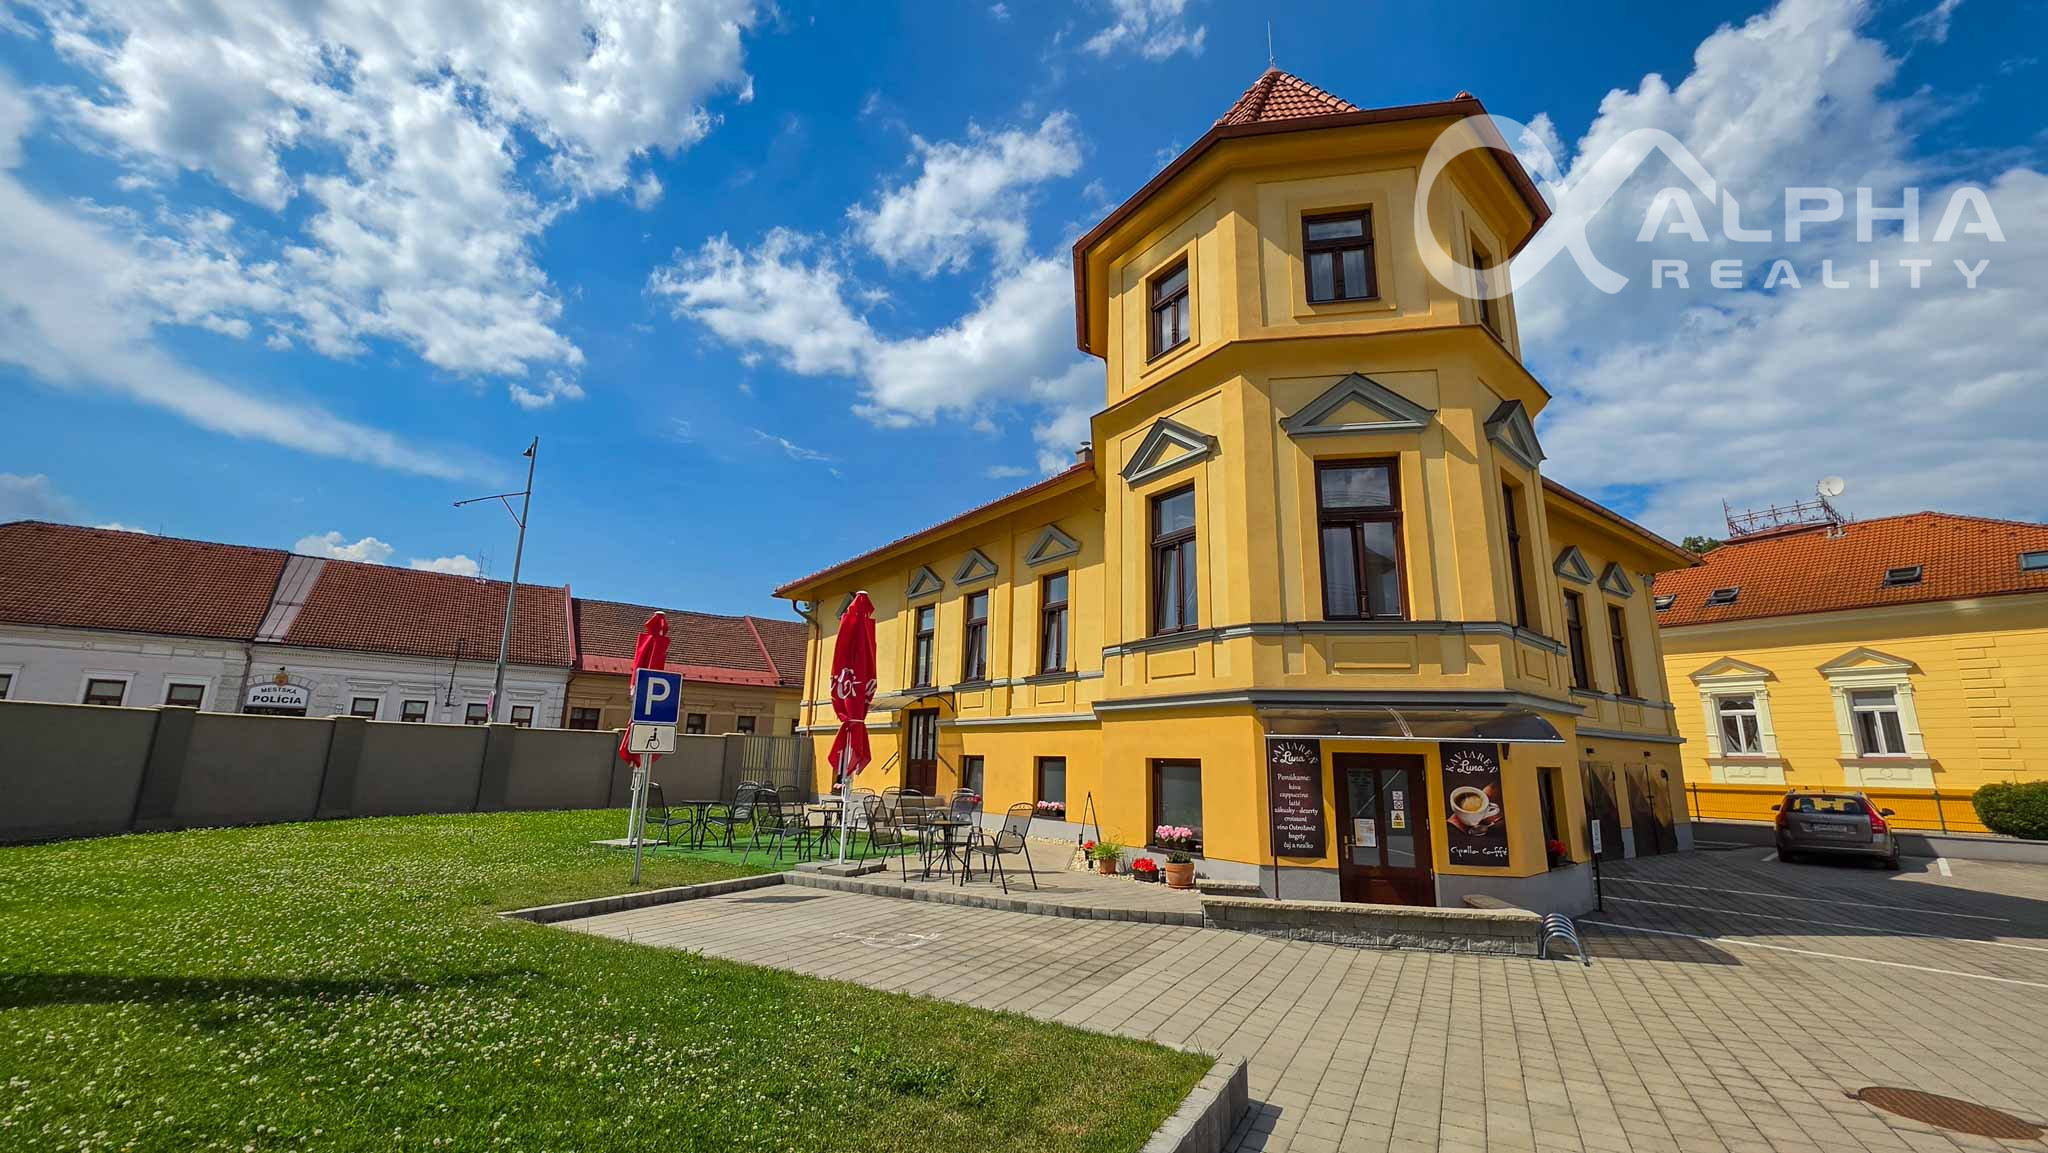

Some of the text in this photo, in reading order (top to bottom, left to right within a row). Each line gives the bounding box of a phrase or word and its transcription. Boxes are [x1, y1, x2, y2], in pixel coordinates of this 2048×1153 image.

[252, 695, 302, 704] POLÍCIA
[645, 677, 671, 715] P
[1280, 751, 1305, 765] Luna
[1457, 760, 1485, 774] Luna
